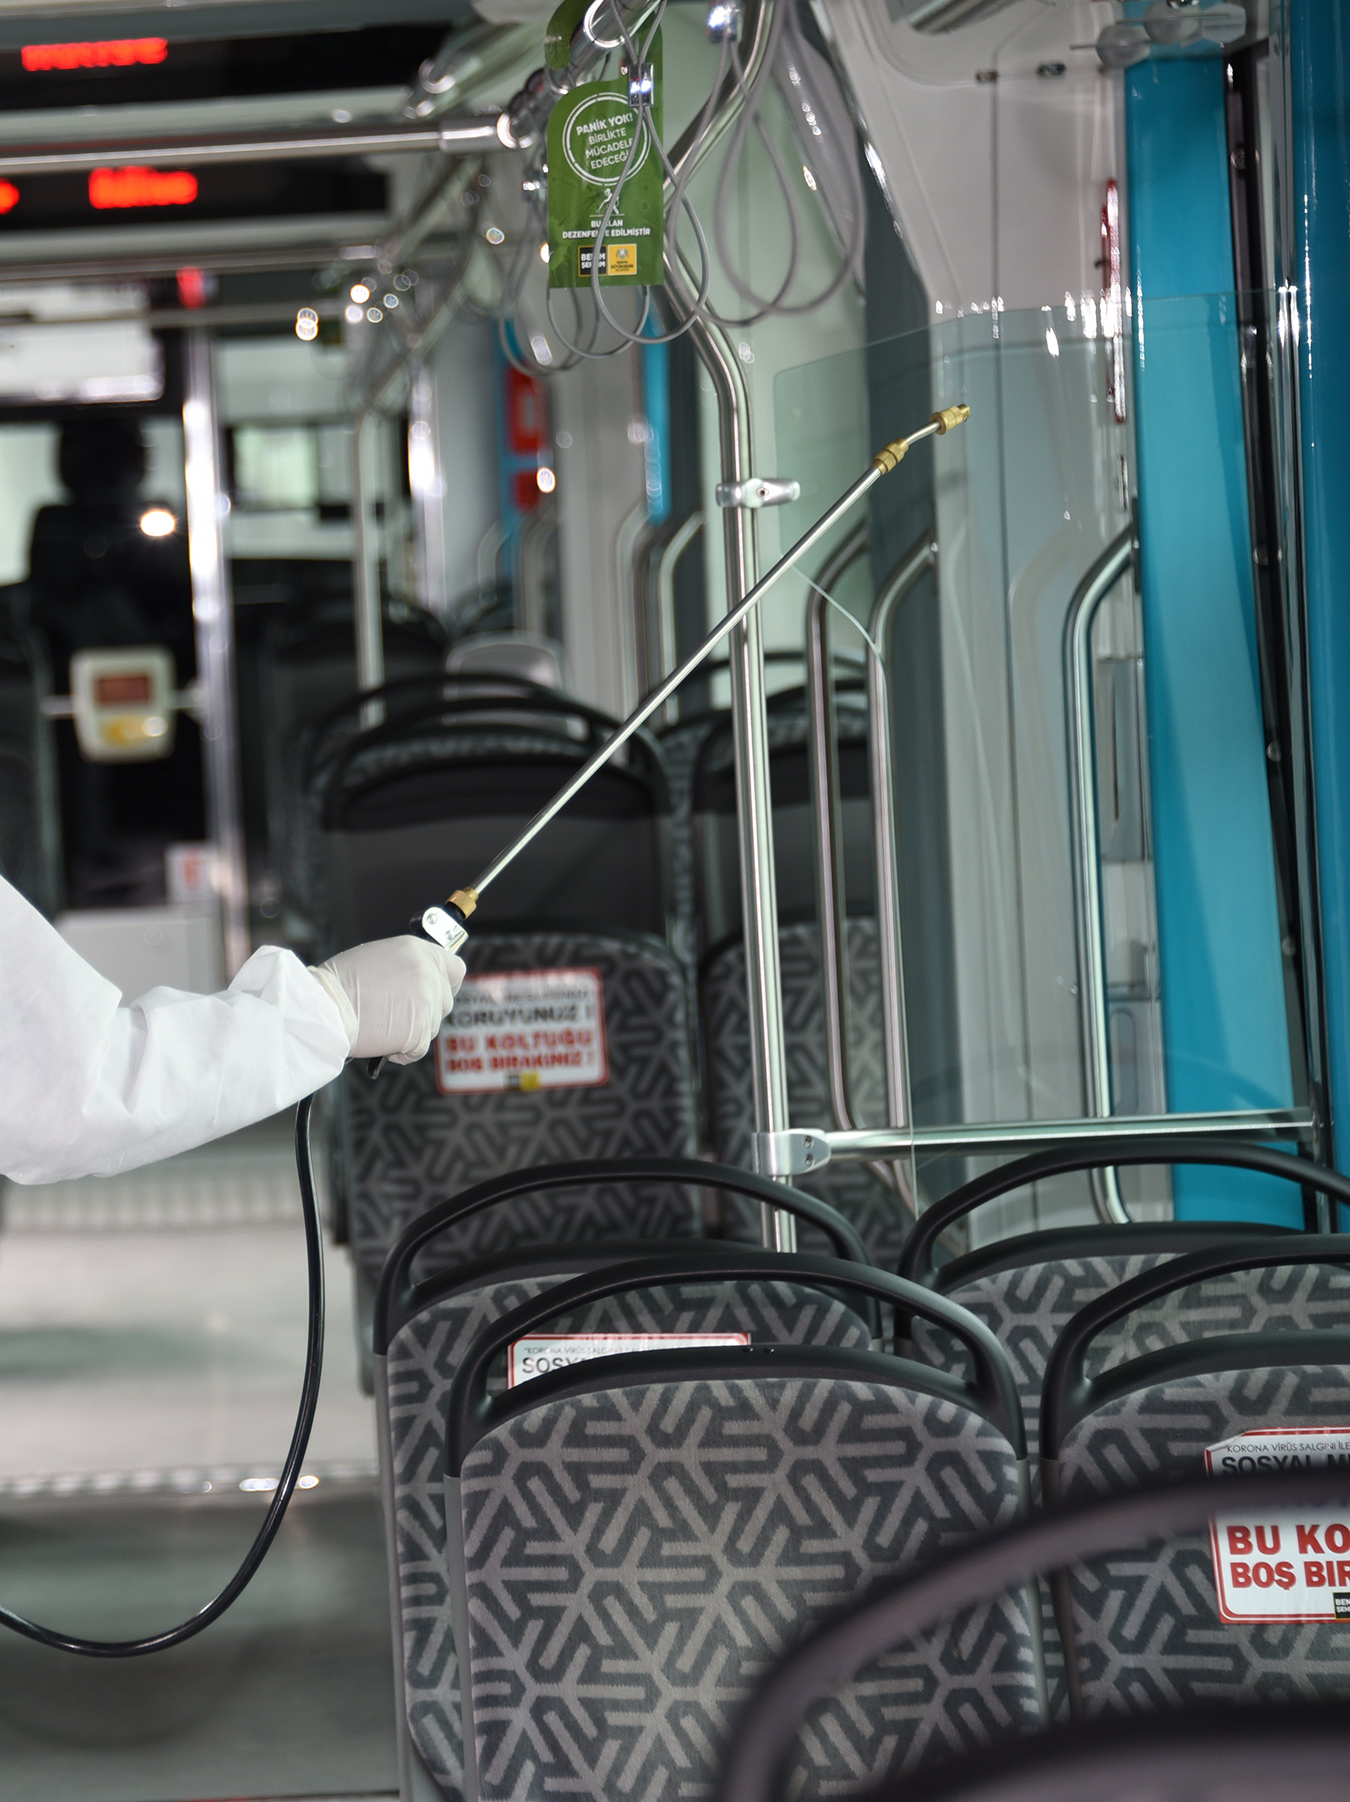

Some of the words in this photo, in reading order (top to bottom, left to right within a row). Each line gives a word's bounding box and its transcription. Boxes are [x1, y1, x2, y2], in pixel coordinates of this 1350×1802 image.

[576, 120, 607, 135] PANİK
[608, 113, 634, 126] YOK!
[588, 128, 626, 145] BİRLİKTE
[446, 1036, 475, 1053] BU
[485, 1028, 593, 1052] KOLTUĞU
[1227, 1444, 1269, 1454] KORONA
[1271, 1441, 1298, 1452] VİRÜS
[1300, 1441, 1337, 1452] SALGINI
[1226, 1525, 1281, 1555] BU
[1230, 1561, 1297, 1590] BOŞ
